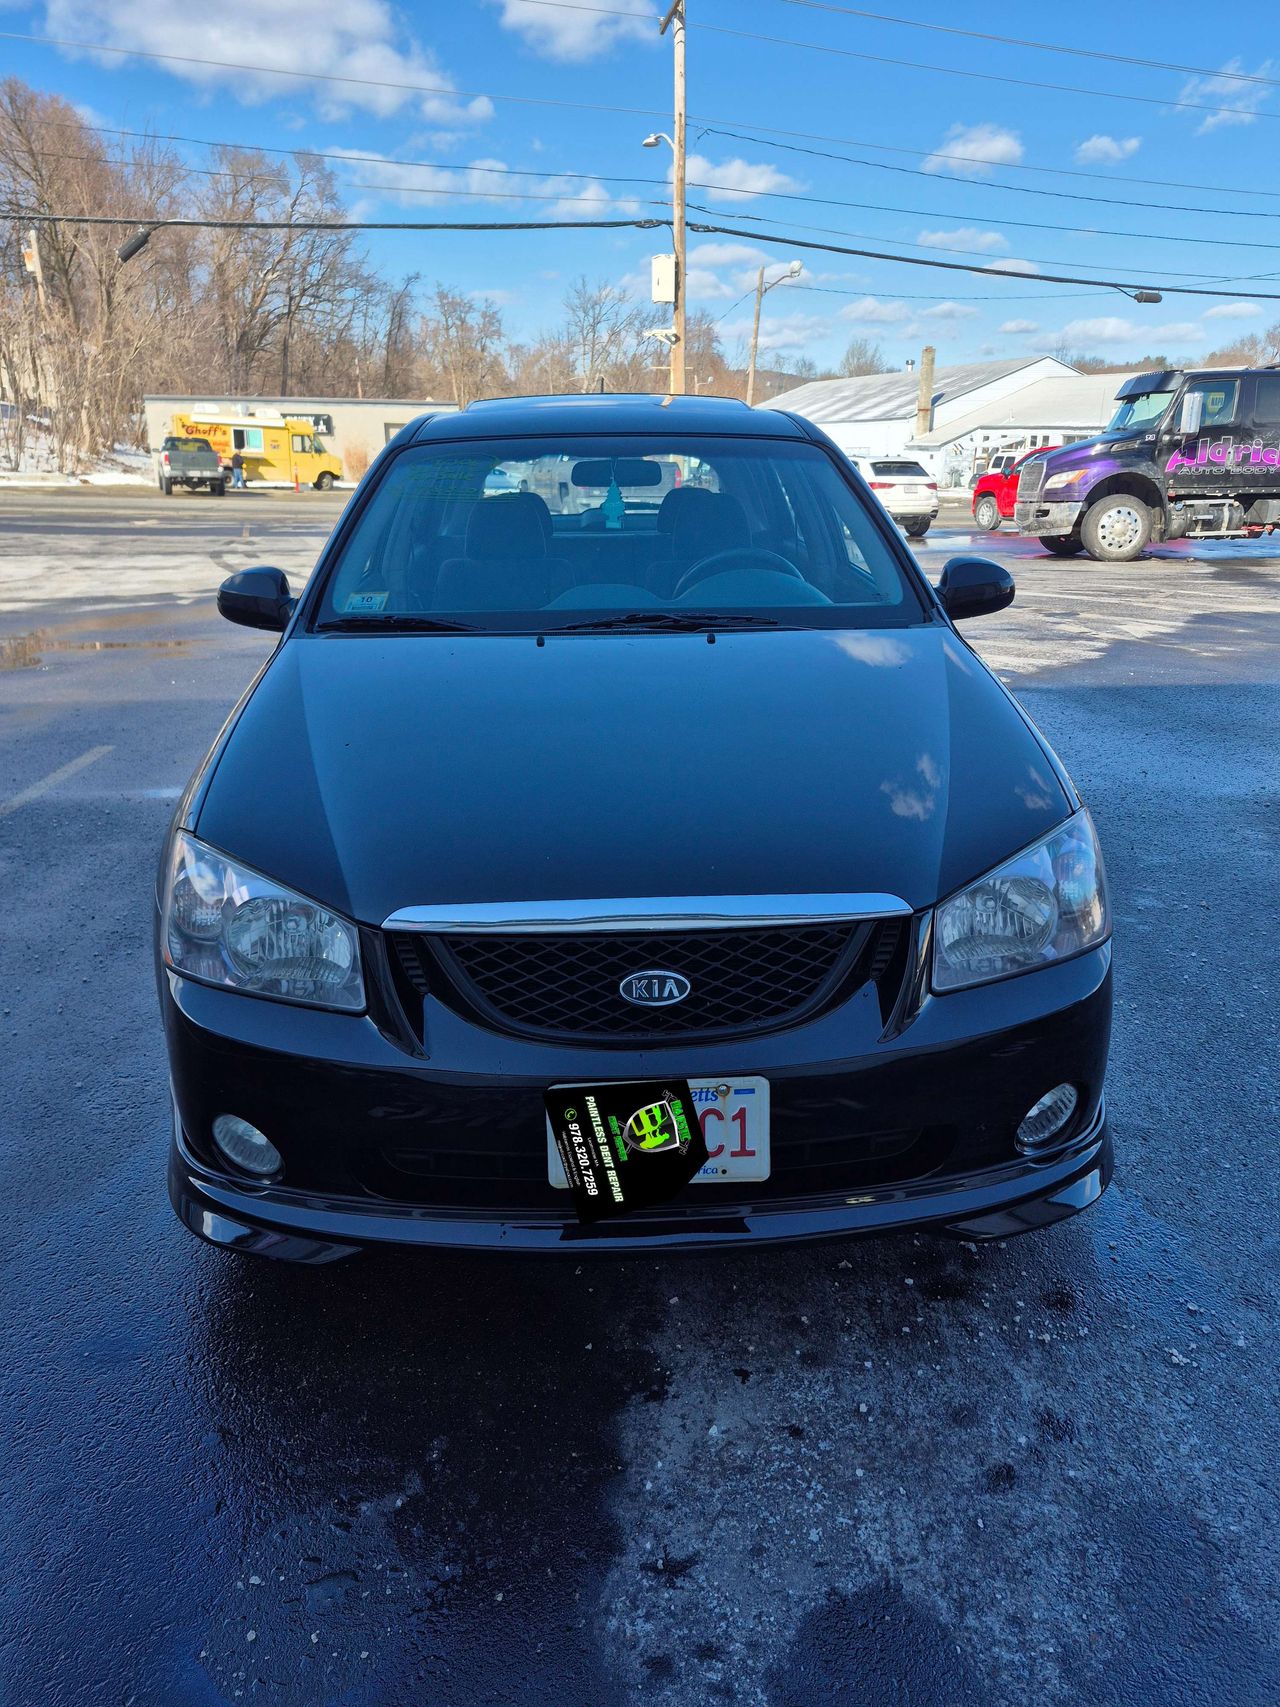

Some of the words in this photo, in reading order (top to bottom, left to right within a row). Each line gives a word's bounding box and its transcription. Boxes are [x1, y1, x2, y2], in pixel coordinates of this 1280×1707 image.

[1165, 436, 1280, 472] Aldric
[1178, 465, 1225, 475] AUTO
[1230, 465, 1278, 475] BODY
[632, 979, 680, 998] KIA
[698, 1108, 756, 1157] C1
